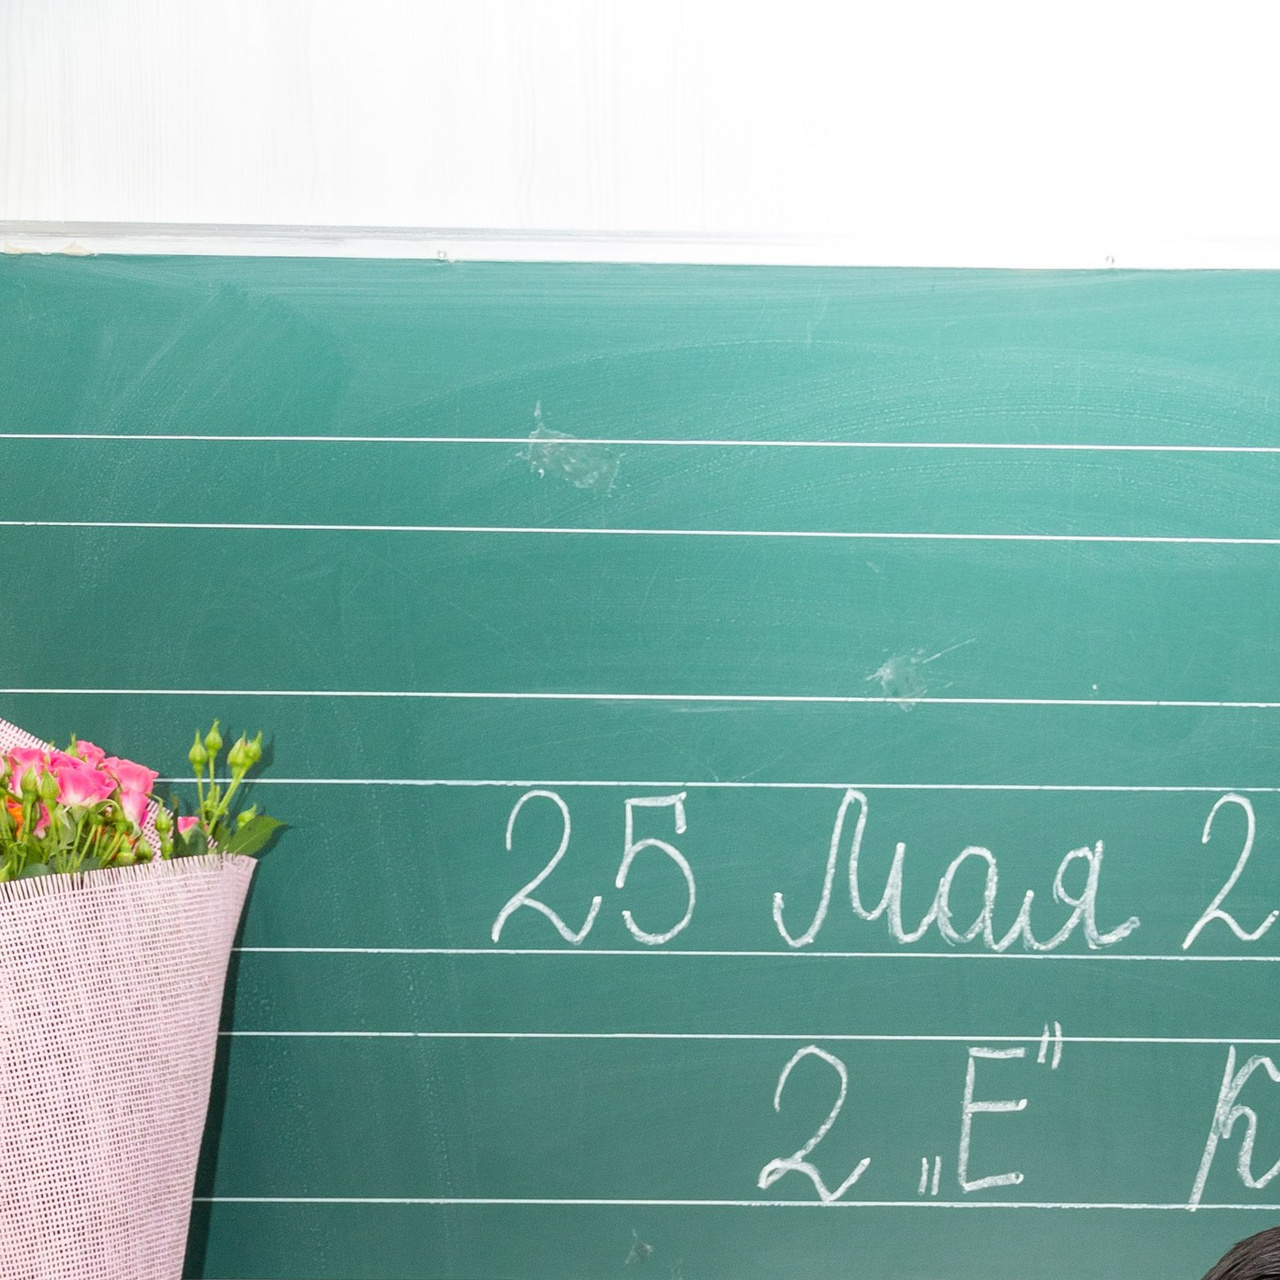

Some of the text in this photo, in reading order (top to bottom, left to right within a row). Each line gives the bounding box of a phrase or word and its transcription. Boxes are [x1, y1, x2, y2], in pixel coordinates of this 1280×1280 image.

[490, 788, 696, 946] 25
[772, 787, 1142, 952] Мая
[757, 1043, 872, 1204] 2
